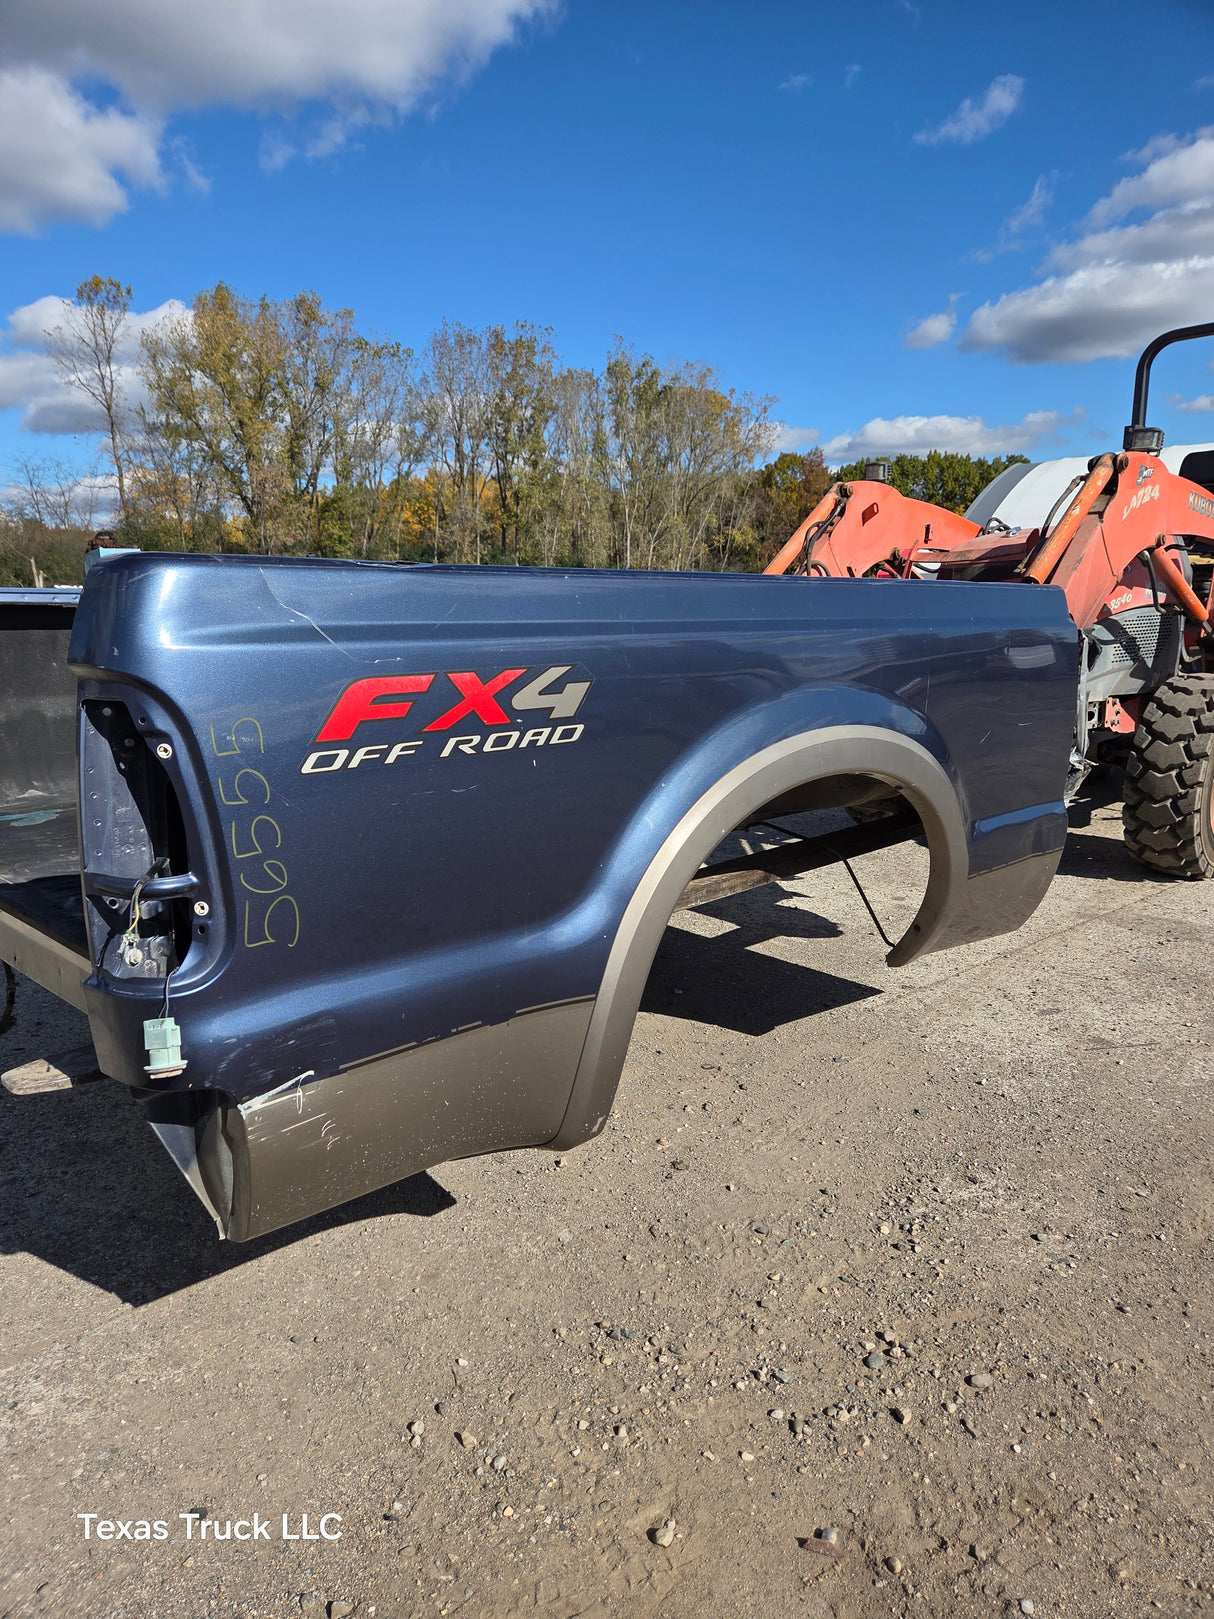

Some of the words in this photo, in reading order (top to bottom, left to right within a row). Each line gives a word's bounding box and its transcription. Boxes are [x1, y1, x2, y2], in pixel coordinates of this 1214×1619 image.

[1122, 484, 1160, 521] LA724
[311, 664, 594, 743] FX4
[299, 740, 424, 775] OFF
[439, 723, 585, 758] ROAD
[210, 717, 300, 948] 56555
